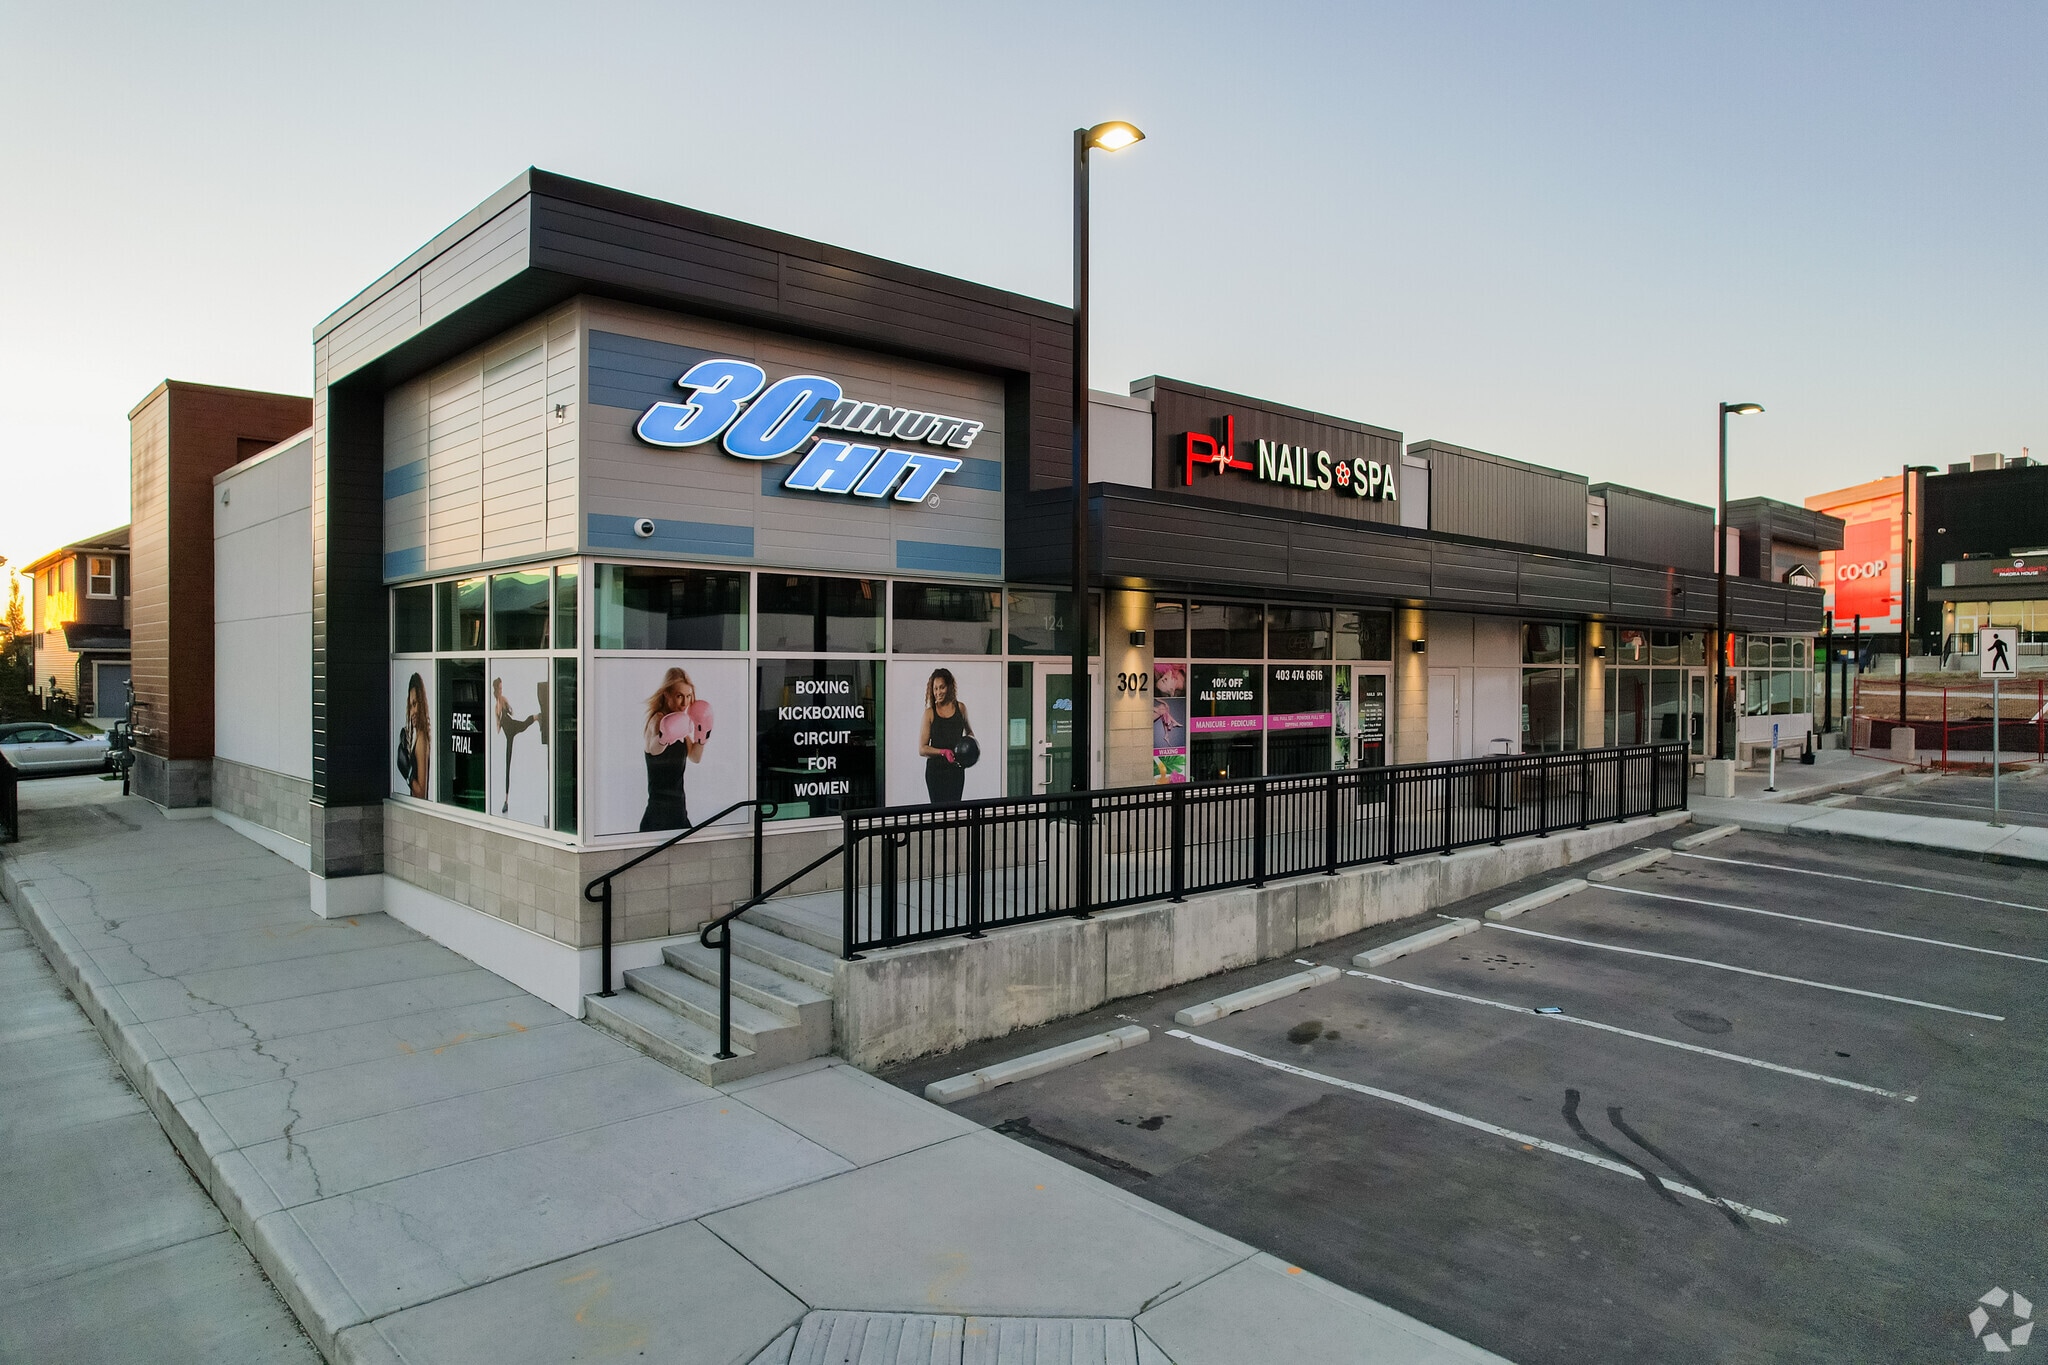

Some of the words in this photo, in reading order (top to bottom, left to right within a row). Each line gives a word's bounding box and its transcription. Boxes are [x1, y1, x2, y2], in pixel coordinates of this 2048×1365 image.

[636, 358, 843, 461] 30
[804, 397, 984, 449] MINUTE
[784, 438, 963, 503] HIT
[1258, 438, 1332, 491] NAILS
[1353, 457, 1397, 501] SPA
[1043, 616, 1064, 631] 124
[1117, 672, 1148, 692] 302
[1211, 677, 1227, 688] 10%
[1228, 678, 1243, 688] OFF
[1275, 669, 1290, 681] 403
[1291, 669, 1305, 681] 474
[1305, 669, 1323, 681] 6616
[795, 680, 849, 694] BOXING
[1200, 690, 1215, 700] ALL
[1216, 690, 1254, 700] SERVICES
[778, 705, 865, 720] KICKBOXING
[452, 712, 472, 730] FREE
[1195, 720, 1226, 729] MANICURE
[1230, 719, 1257, 727] PEDICURE
[451, 735, 473, 754] TRIAL
[793, 730, 851, 745] CIRCUIT
[807, 756, 837, 770] FOR
[794, 780, 849, 797] WOMEN
